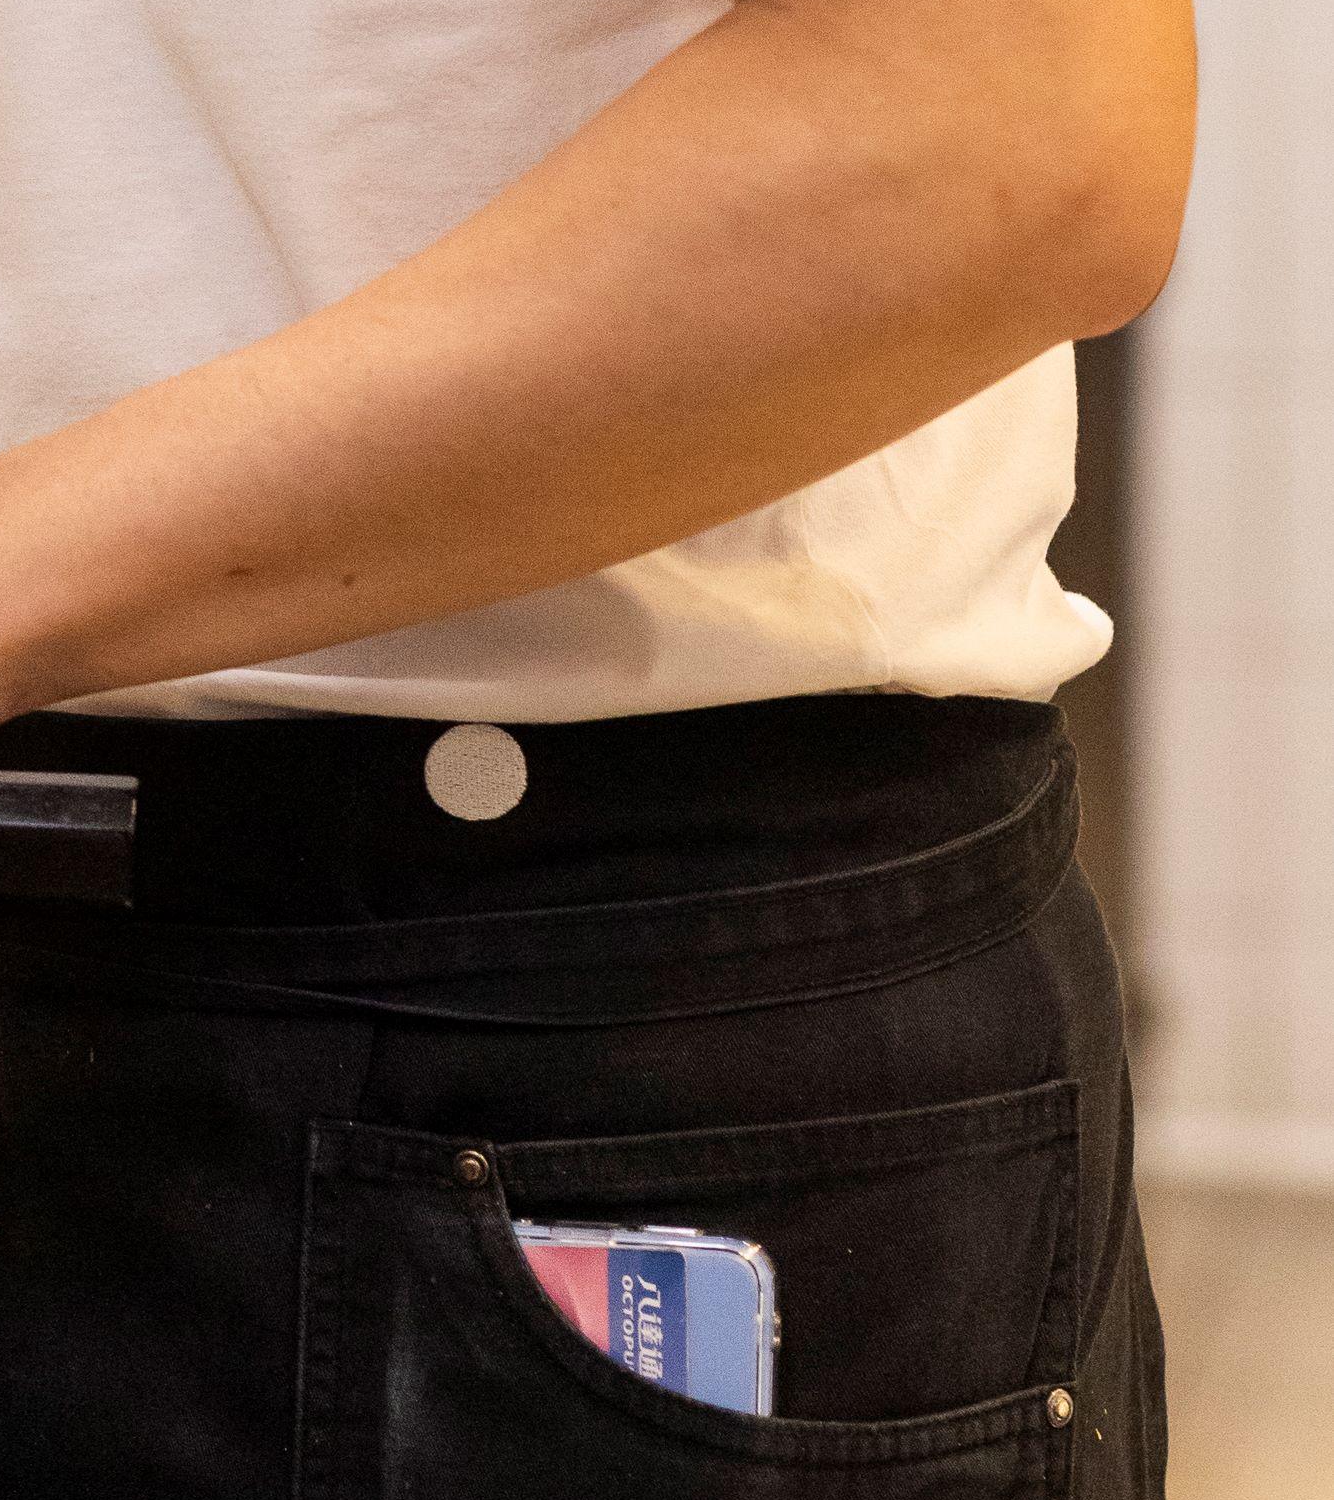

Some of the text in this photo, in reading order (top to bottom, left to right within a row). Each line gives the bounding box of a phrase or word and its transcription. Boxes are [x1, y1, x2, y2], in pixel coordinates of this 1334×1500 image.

[622, 1275, 634, 1371] OCTOPU
[636, 1274, 663, 1379] 八達通
